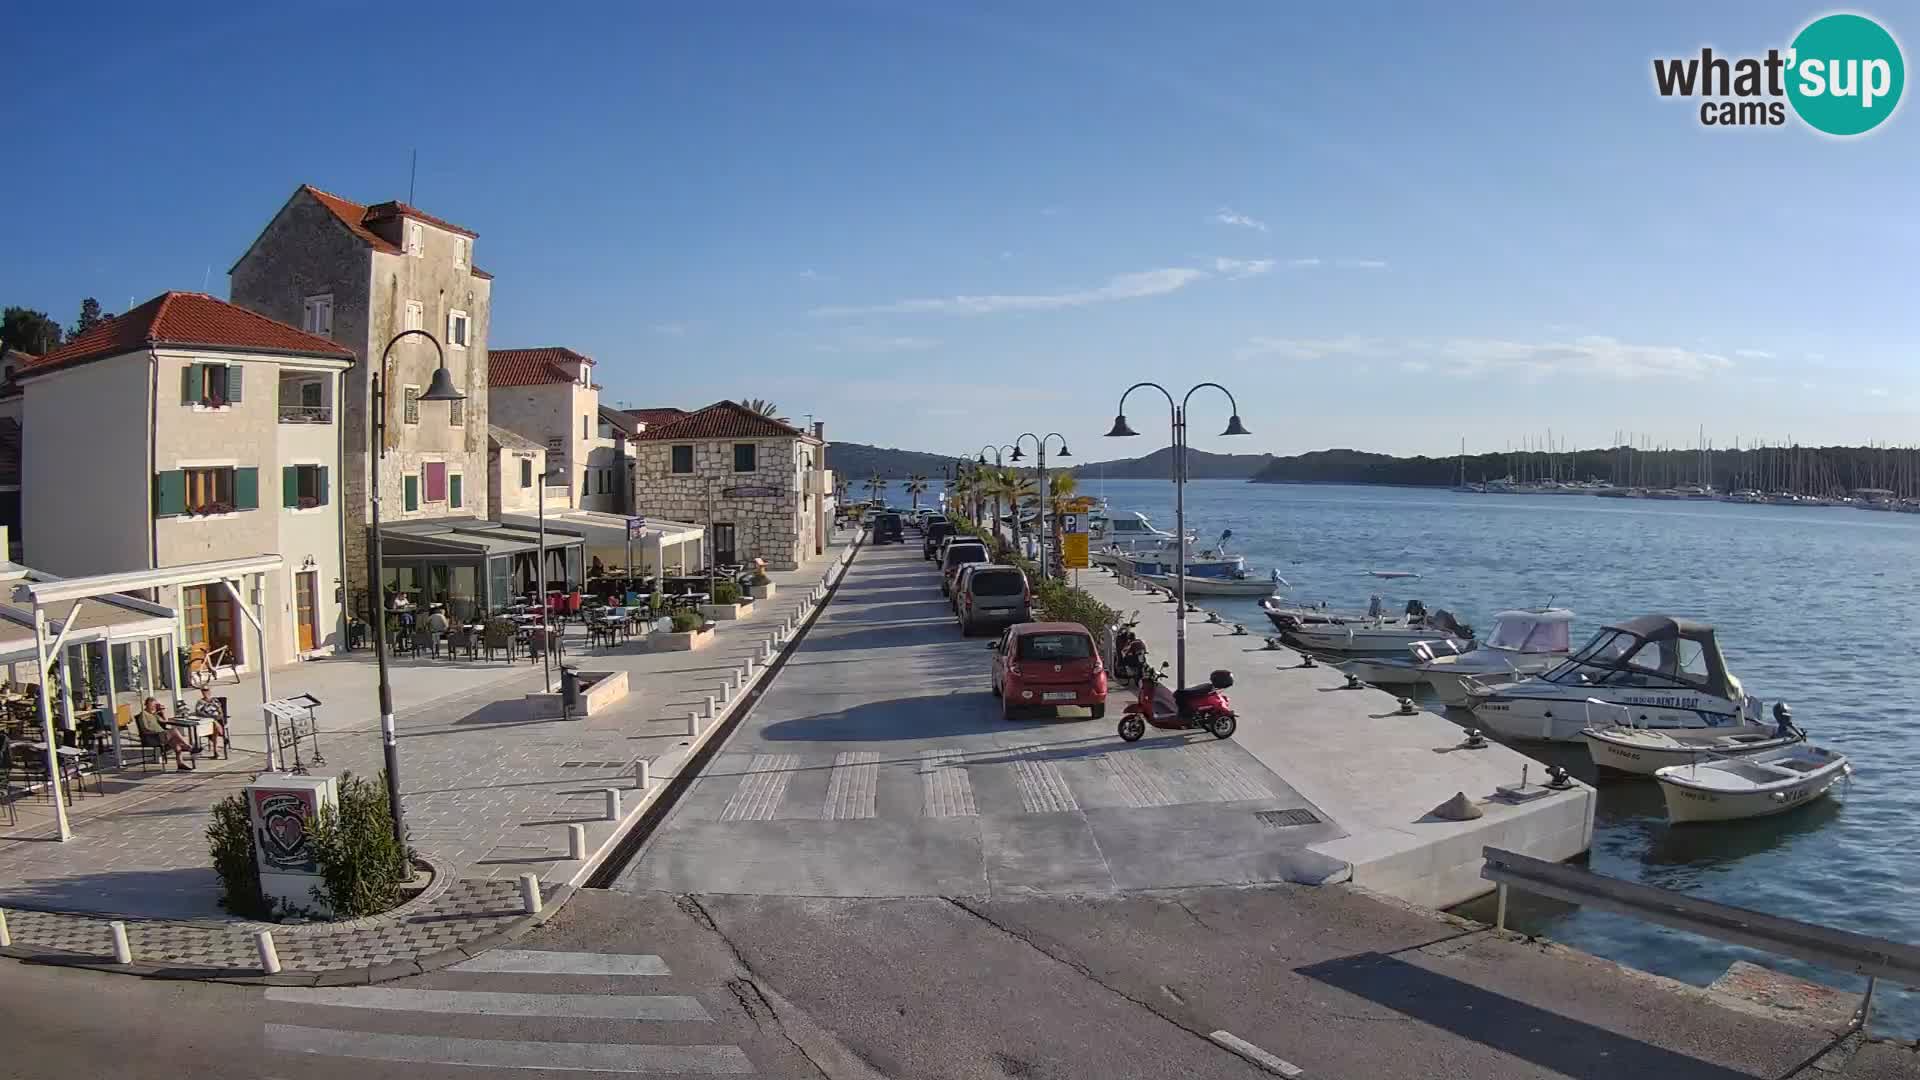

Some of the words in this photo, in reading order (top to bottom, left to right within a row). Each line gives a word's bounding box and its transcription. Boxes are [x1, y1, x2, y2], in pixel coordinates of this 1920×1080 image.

[1065, 515, 1076, 531] P
[1656, 697, 1674, 706] RENT
[1682, 698, 1698, 708] BOAT
